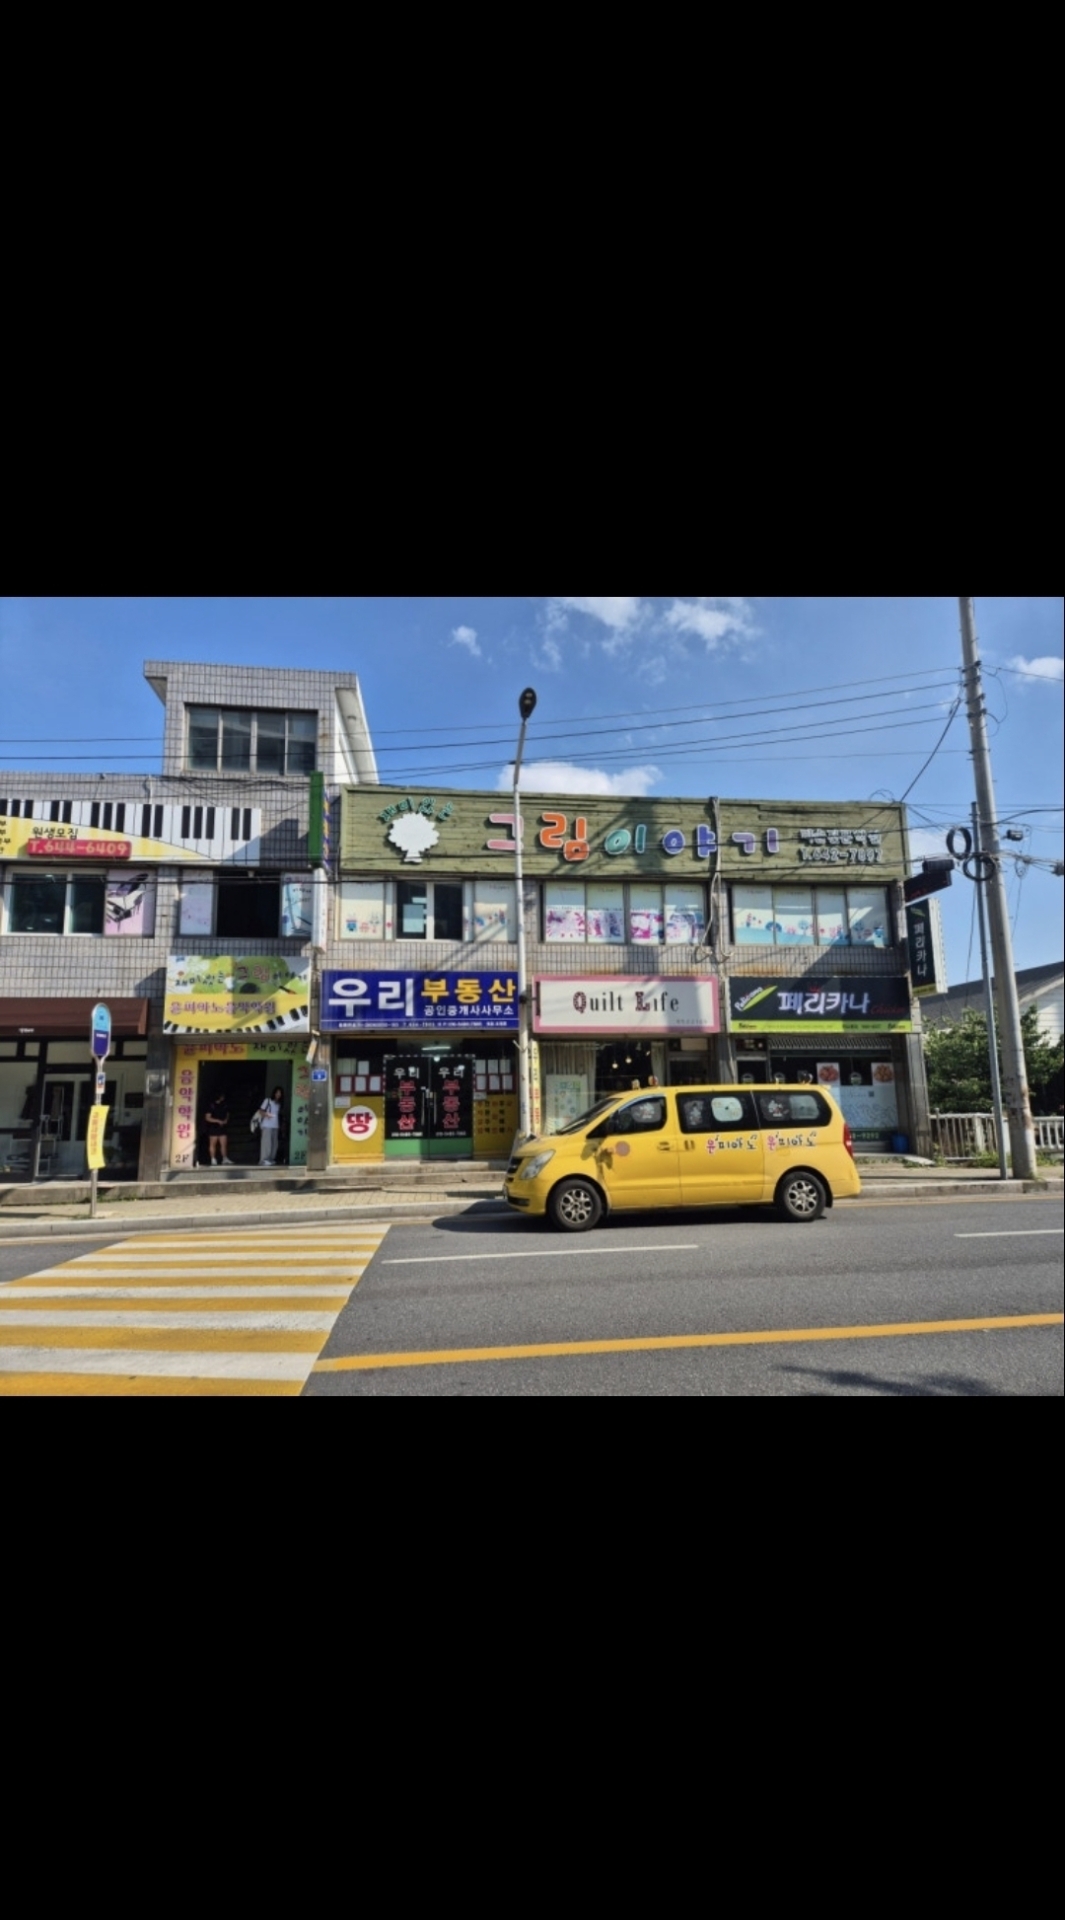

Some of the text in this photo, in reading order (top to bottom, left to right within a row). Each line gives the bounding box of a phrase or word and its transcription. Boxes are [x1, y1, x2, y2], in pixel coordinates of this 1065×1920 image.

[377, 797, 453, 823] 재미있는
[32, 827, 78, 840] 원생모집
[486, 812, 779, 861] 그림 이야기
[29, 840, 127, 854] T.644-6409
[913, 922, 927, 977] 페리카나
[328, 978, 515, 1017] 우리 부동산
[573, 991, 679, 1014] Quilt Life
[777, 992, 870, 1014] 페리카나
[423, 1005, 513, 1016] 공인중개사사무소
[394, 1068, 419, 1078] 우리
[438, 1067, 463, 1078] 우리
[177, 1069, 194, 1139] 음악학원
[398, 1079, 415, 1130] 부동산
[443, 1079, 459, 1129] 부동산
[346, 1112, 372, 1134] 땅
[175, 1154, 189, 1163] 2F
